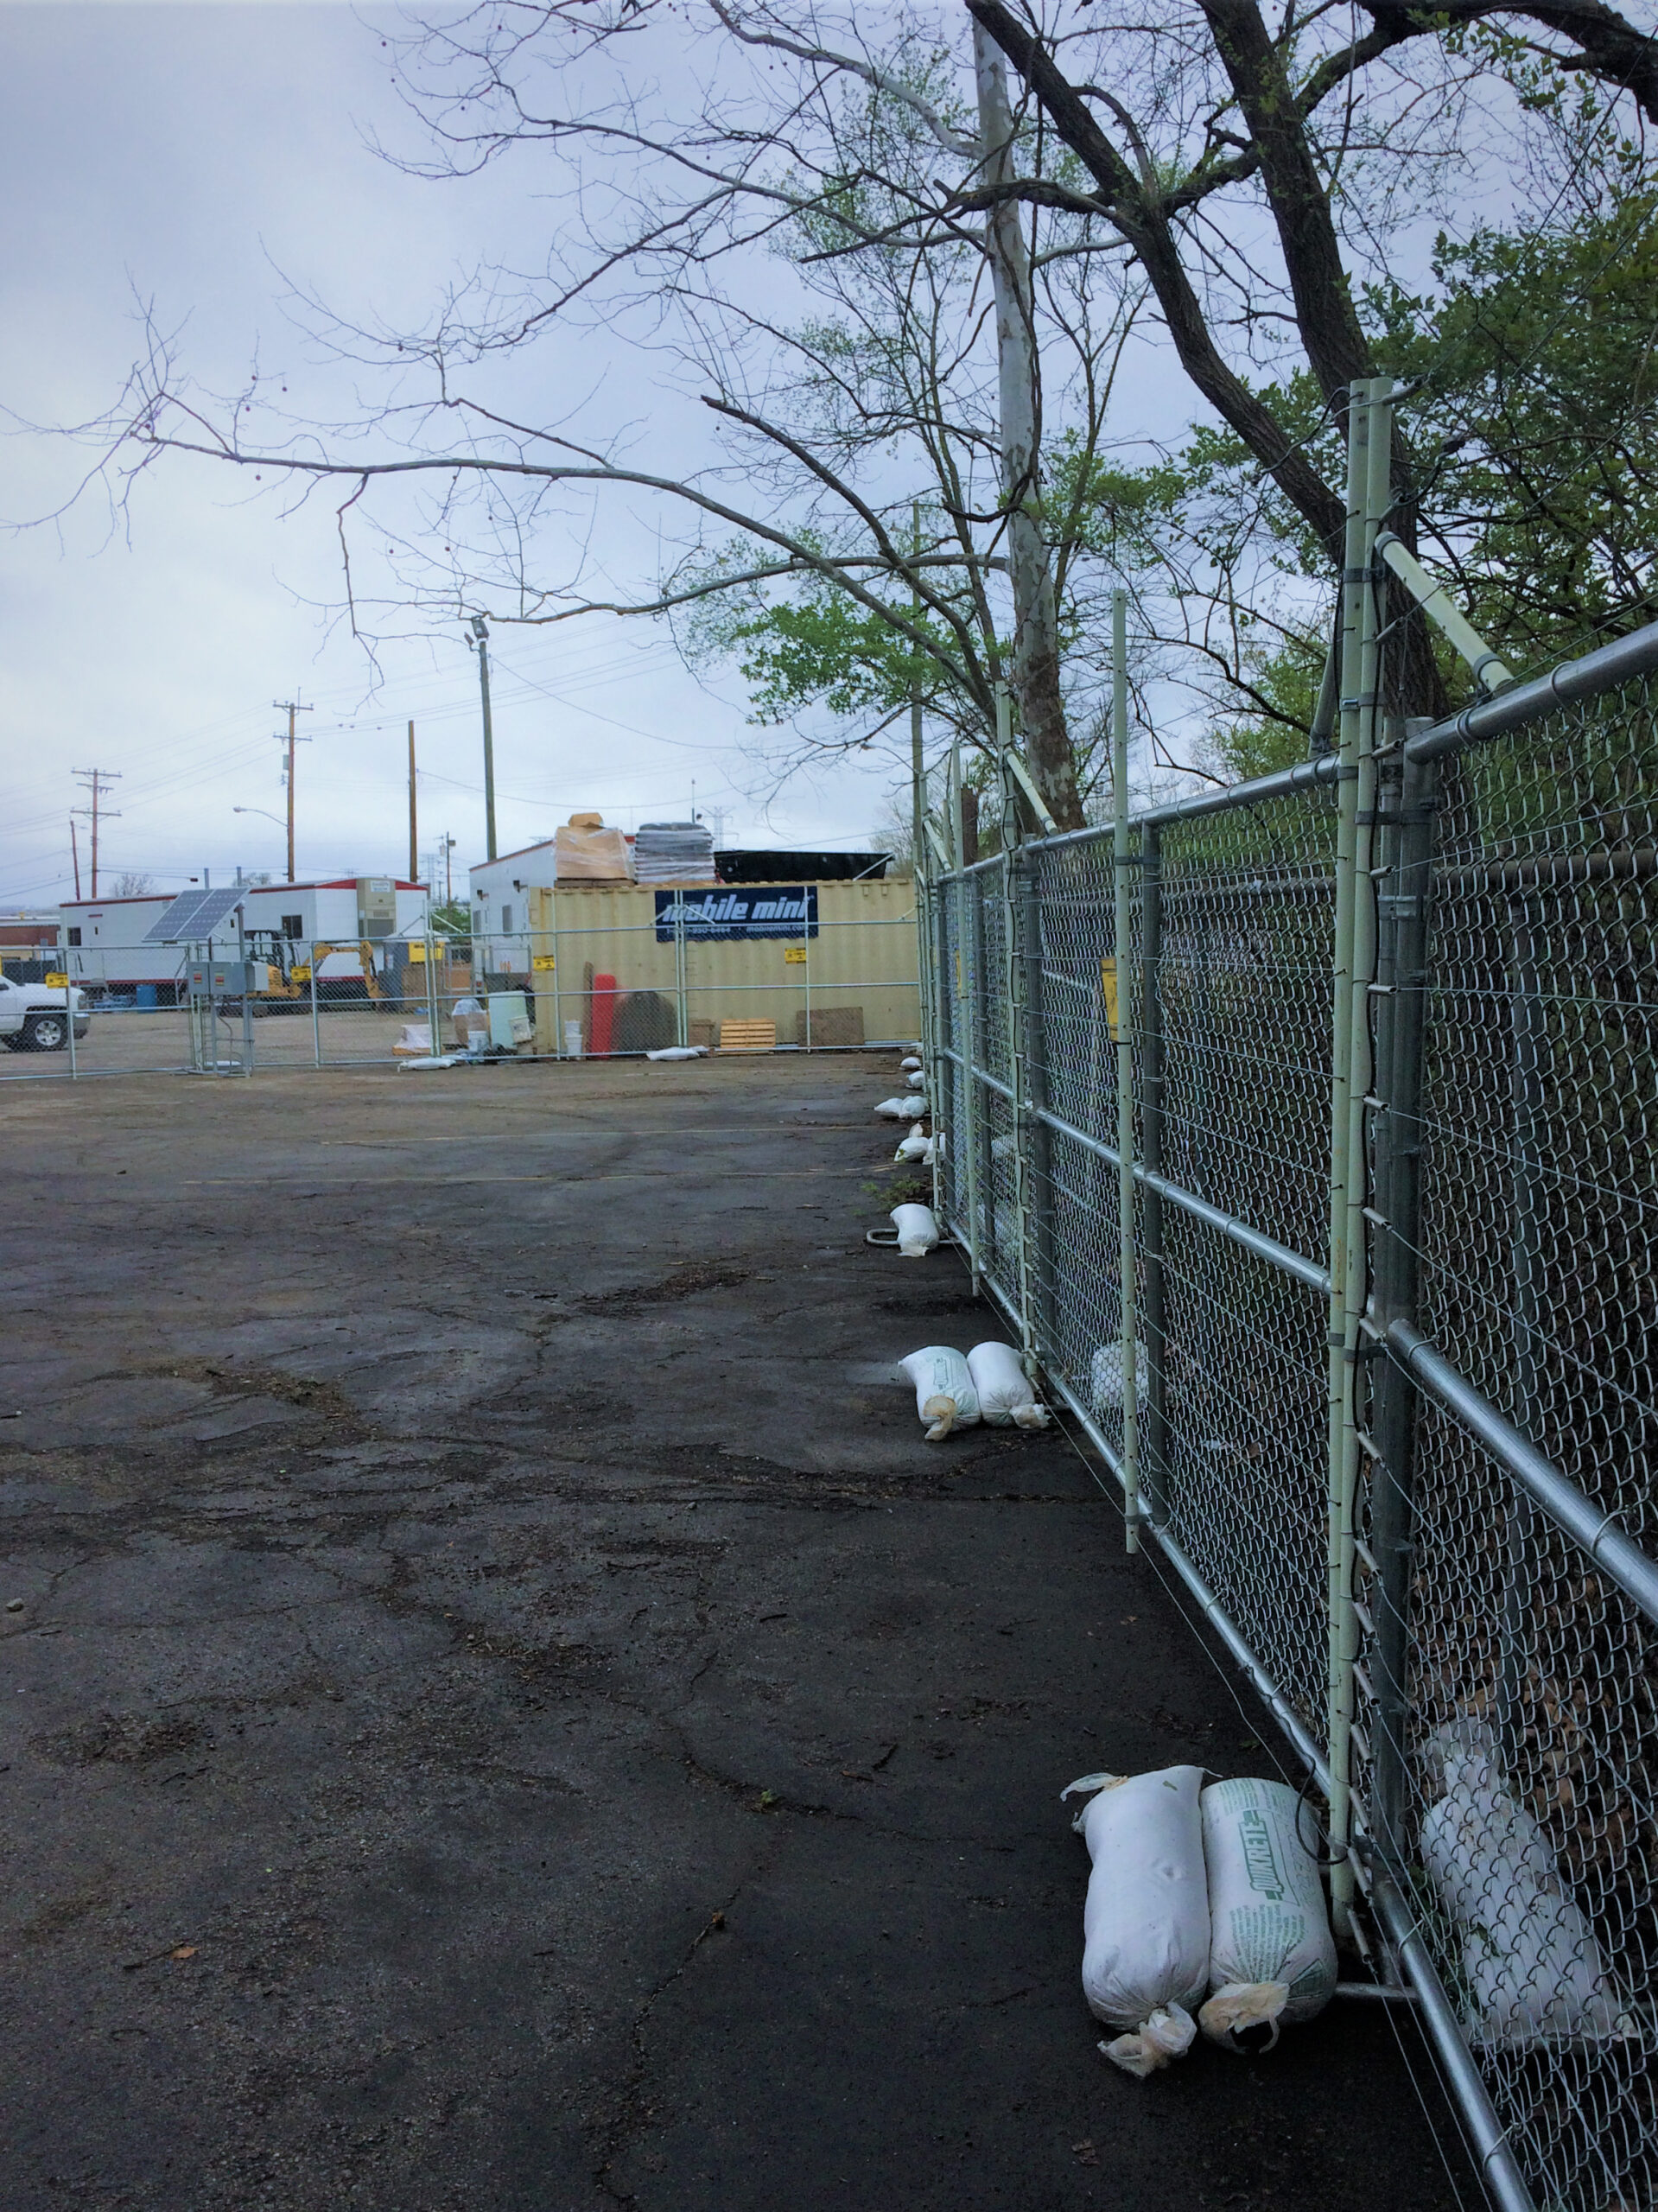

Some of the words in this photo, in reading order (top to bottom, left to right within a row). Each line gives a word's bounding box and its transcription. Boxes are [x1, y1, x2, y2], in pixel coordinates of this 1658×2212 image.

[662, 894, 748, 922] mobile
[751, 896, 810, 919] mini
[1238, 1821, 1284, 1893] QUIKRETE
